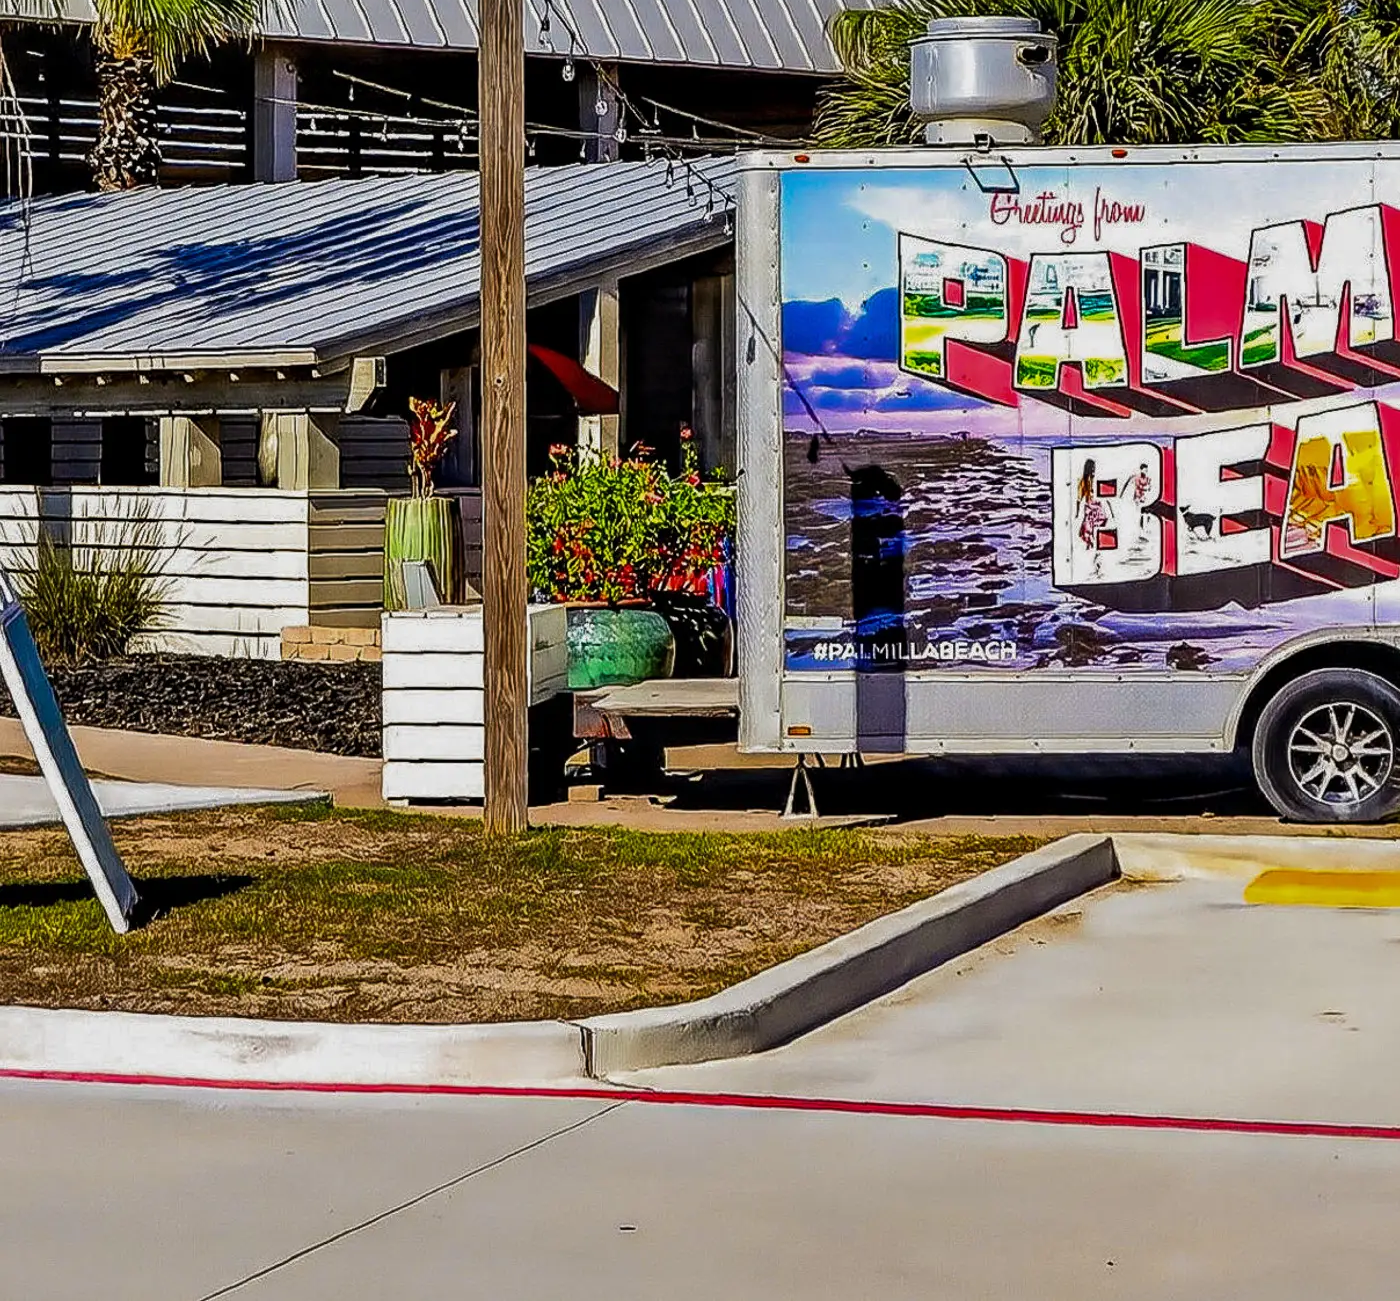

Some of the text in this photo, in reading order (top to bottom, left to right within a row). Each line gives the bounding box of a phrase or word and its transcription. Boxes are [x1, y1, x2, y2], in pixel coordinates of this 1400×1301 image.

[990, 186, 1145, 244] Greetings from
[813, 640, 1017, 661] #PALMILLABEACH
